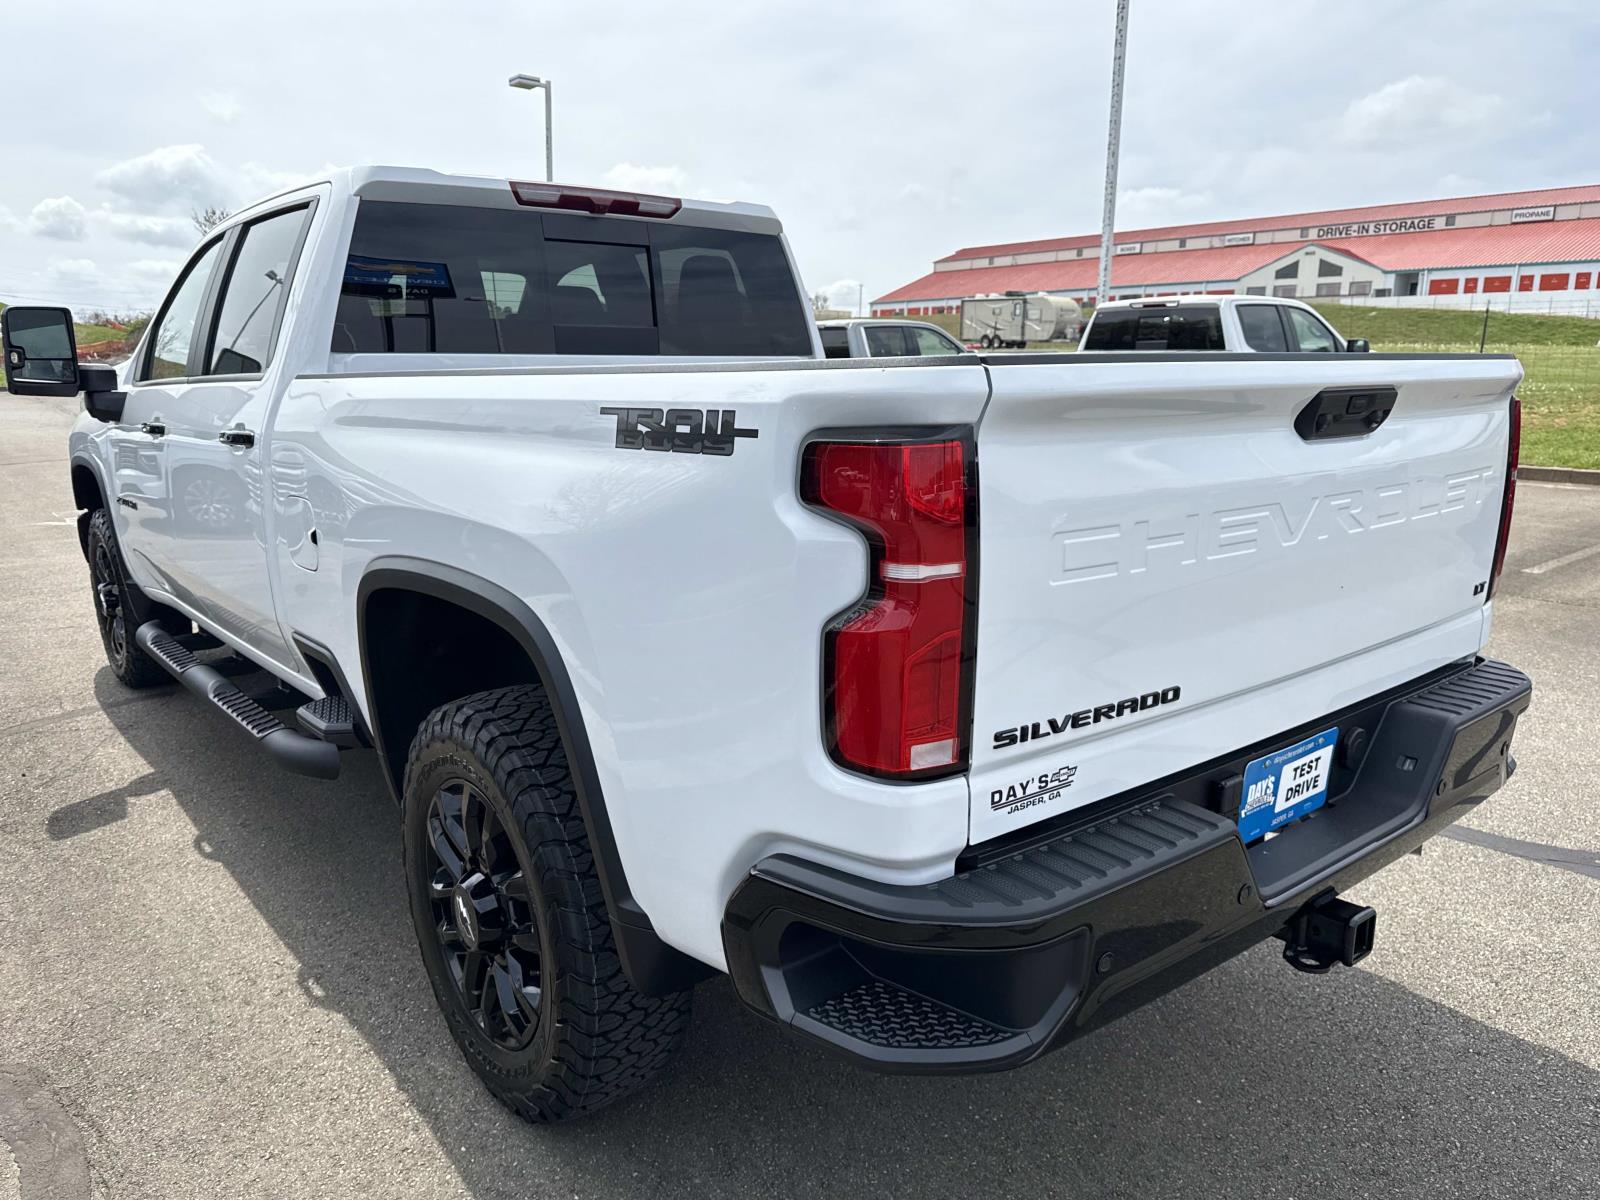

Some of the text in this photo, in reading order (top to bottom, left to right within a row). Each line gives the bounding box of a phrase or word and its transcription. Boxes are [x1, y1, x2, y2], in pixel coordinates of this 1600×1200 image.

[1514, 209, 1552, 220] PROPANE
[1317, 219, 1436, 238] DRIVE-IN STORAGE
[1050, 465, 1494, 586] CHEVROLET
[1473, 581, 1487, 597] LT
[993, 685, 1181, 749] SILVERADO
[1293, 756, 1321, 781] TEST
[991, 773, 1049, 806] DAY'S
[1247, 774, 1275, 801] DAY'S
[1285, 775, 1320, 802] DRIVE
[1007, 790, 1061, 815] JASPER, GA
